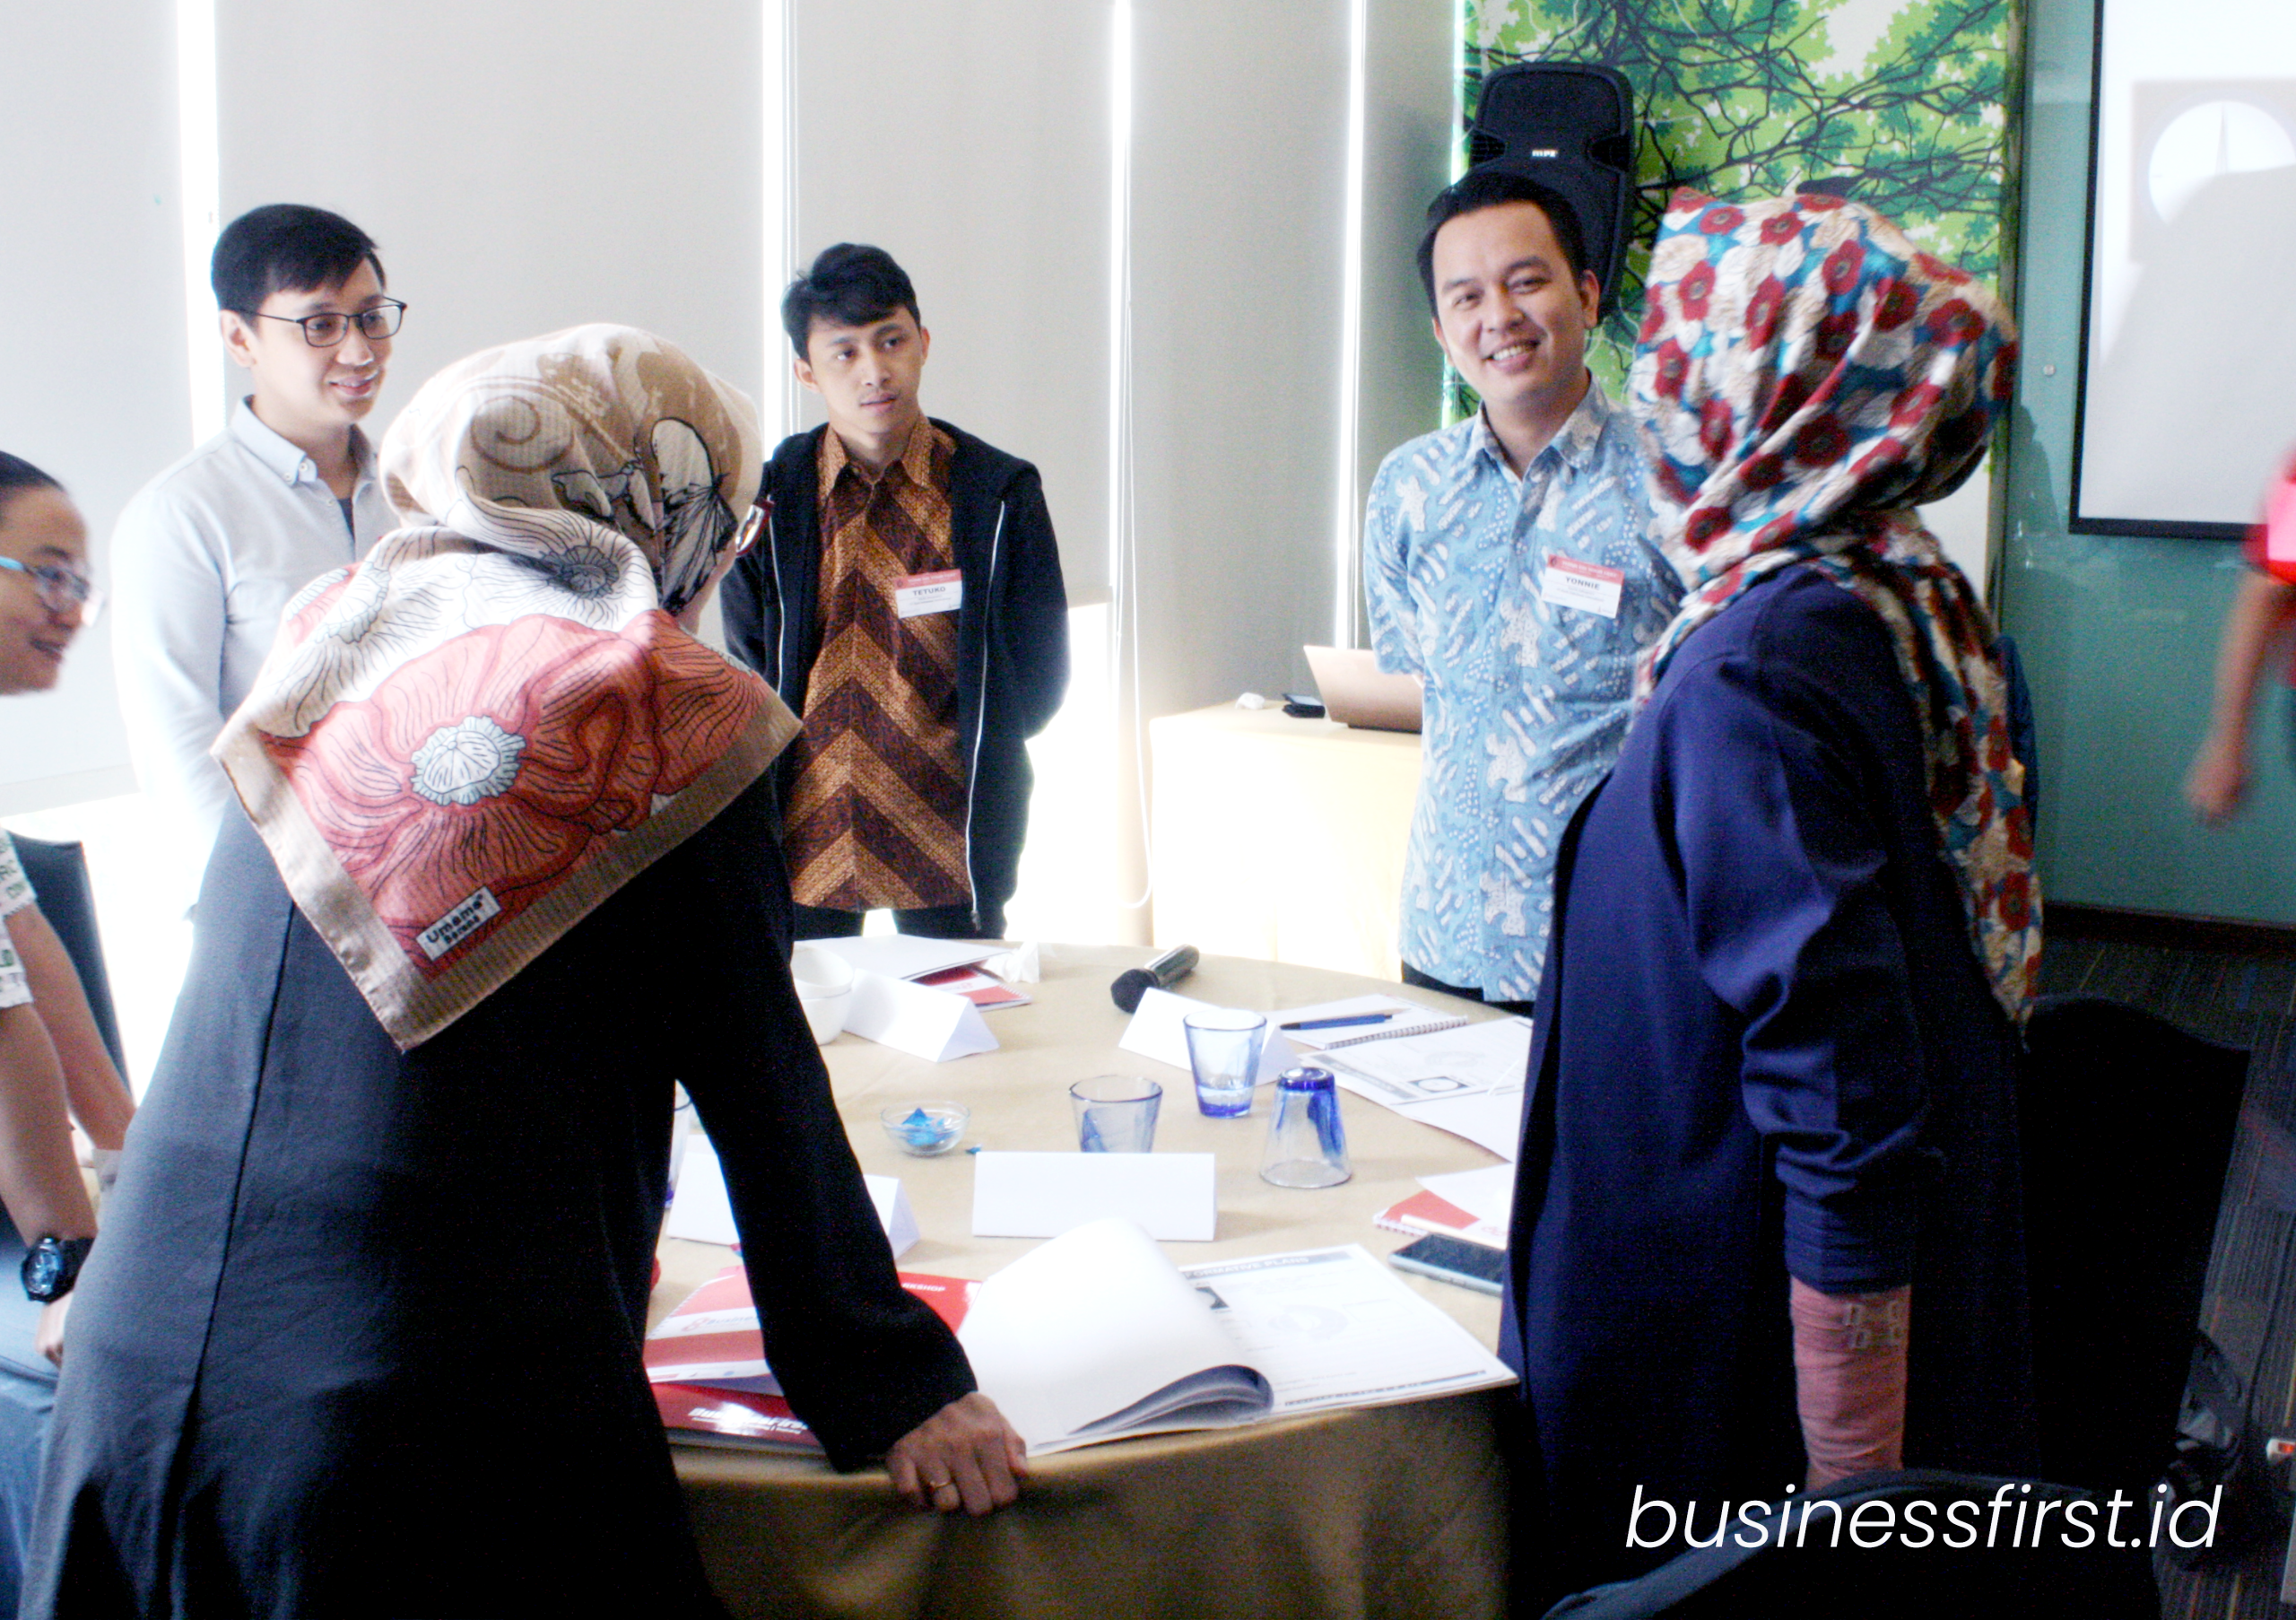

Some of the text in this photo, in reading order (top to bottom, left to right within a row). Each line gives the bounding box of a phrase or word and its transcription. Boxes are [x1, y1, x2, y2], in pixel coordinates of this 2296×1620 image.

[1565, 576, 1601, 591] YONNIE
[913, 586, 946, 597] TETUKO
[426, 899, 483, 944] Umama
[900, 1282, 946, 1293] RKSHOP
